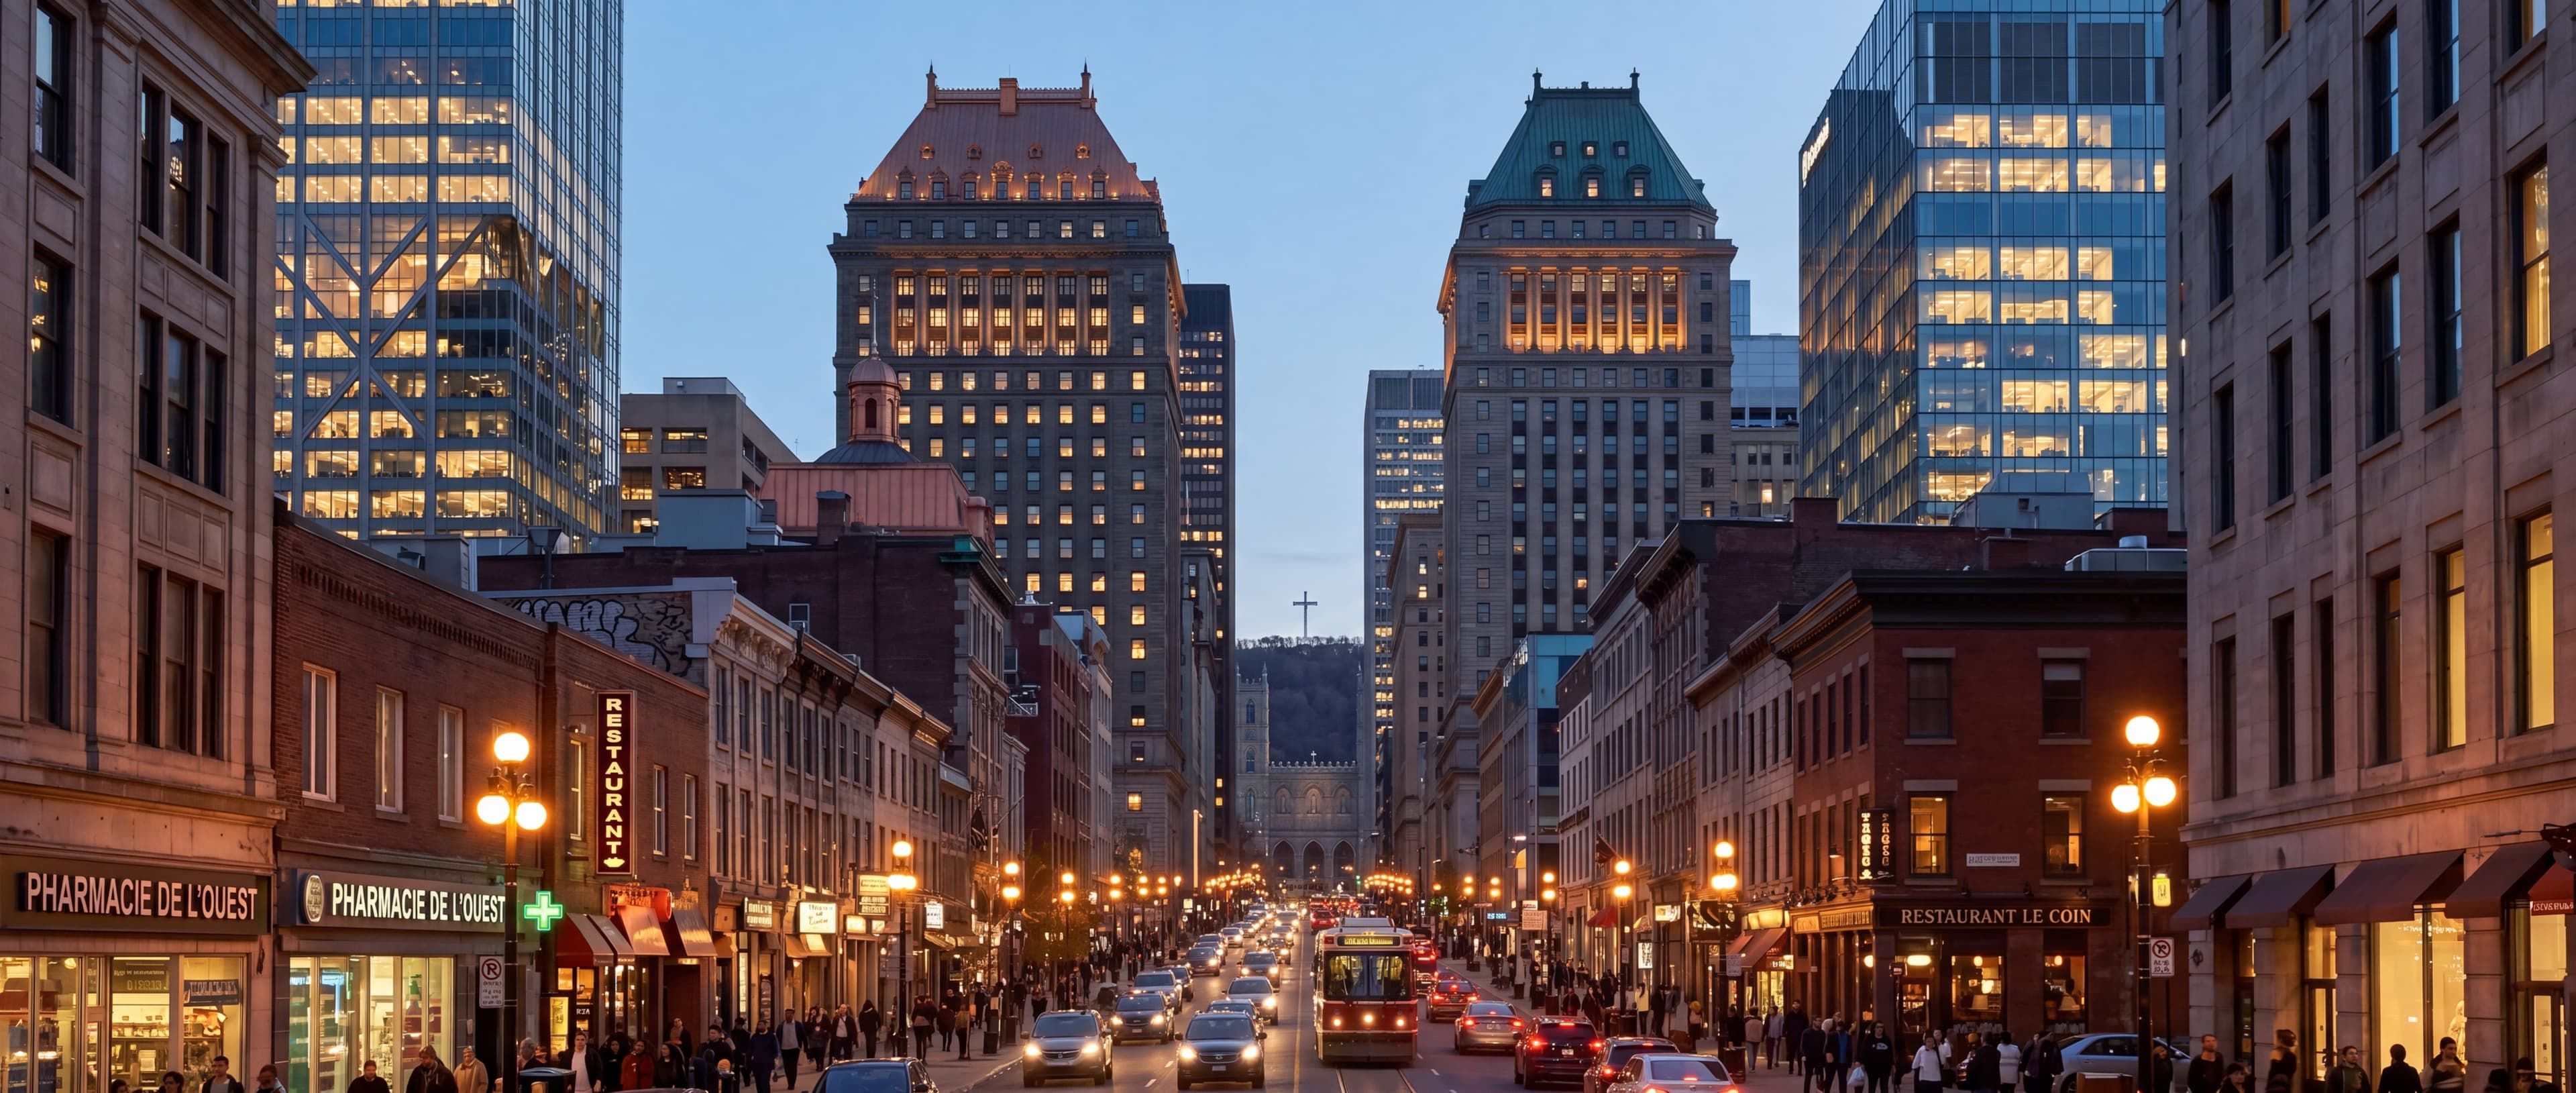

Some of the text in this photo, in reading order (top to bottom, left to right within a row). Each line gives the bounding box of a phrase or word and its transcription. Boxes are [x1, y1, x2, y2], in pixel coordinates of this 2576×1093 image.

[604, 698, 624, 854] RESTAURANT
[27, 872, 258, 920] PHARMACIE DE L'OUEST
[332, 882, 425, 920] PHARMACIE
[430, 890, 448, 921] DE
[453, 892, 506, 923] L'OUEST
[1902, 908, 2092, 923] RESTAURANT LE COIN
